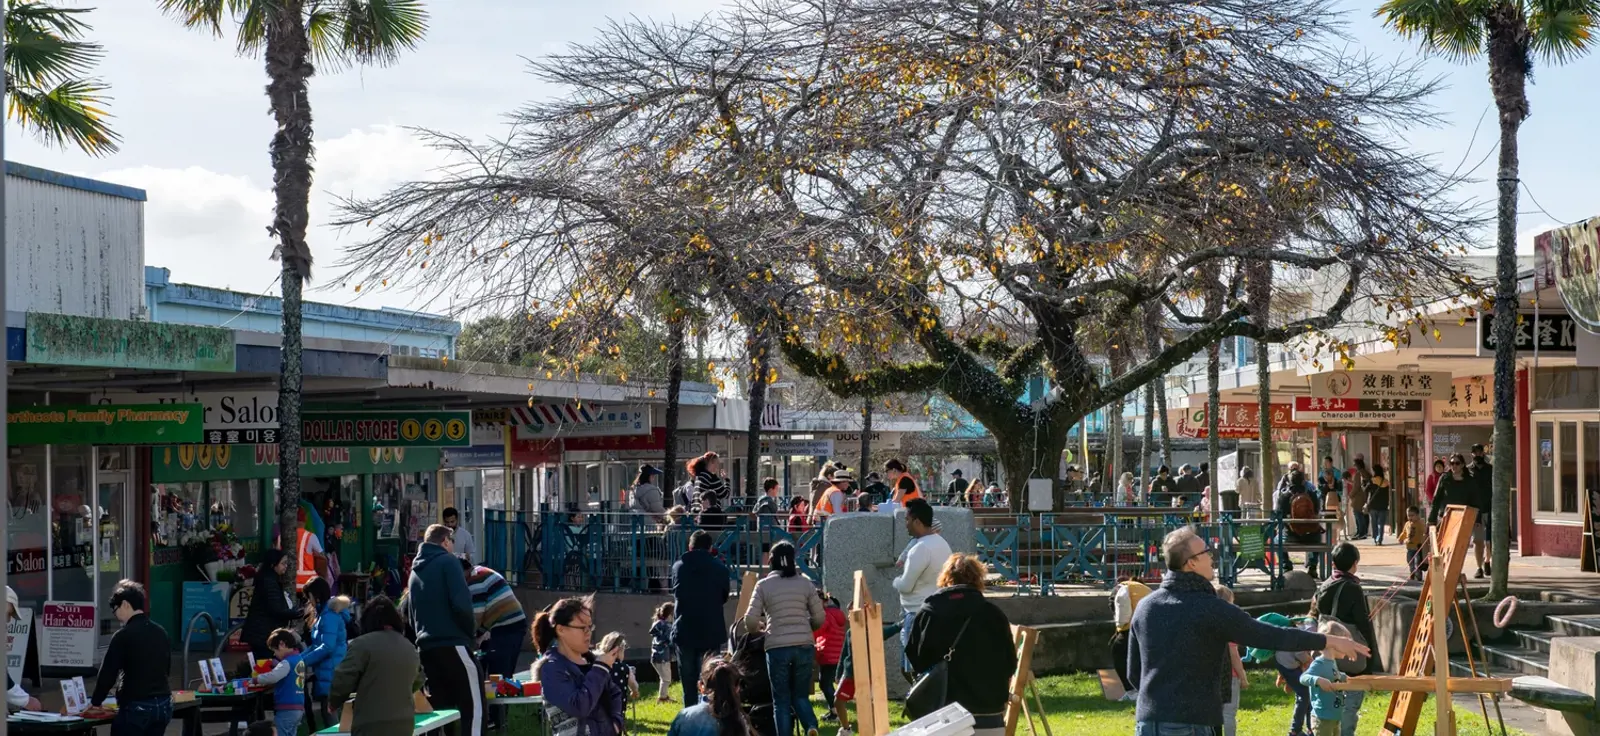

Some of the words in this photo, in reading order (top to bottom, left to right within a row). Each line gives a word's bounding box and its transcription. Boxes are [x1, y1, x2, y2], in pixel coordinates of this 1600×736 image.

[7, 410, 65, 423] orthcote
[67, 409, 116, 425] Family
[117, 408, 189, 424] Pharmacy
[1359, 411, 1396, 420] Barbeque
[303, 419, 353, 441] DOLLAR
[356, 419, 399, 440] STORE
[16, 552, 46, 573] Salon
[56, 603, 81, 613] Sun
[7, 620, 28, 634] alon
[44, 613, 66, 627] Hair
[67, 614, 93, 628] Salon
